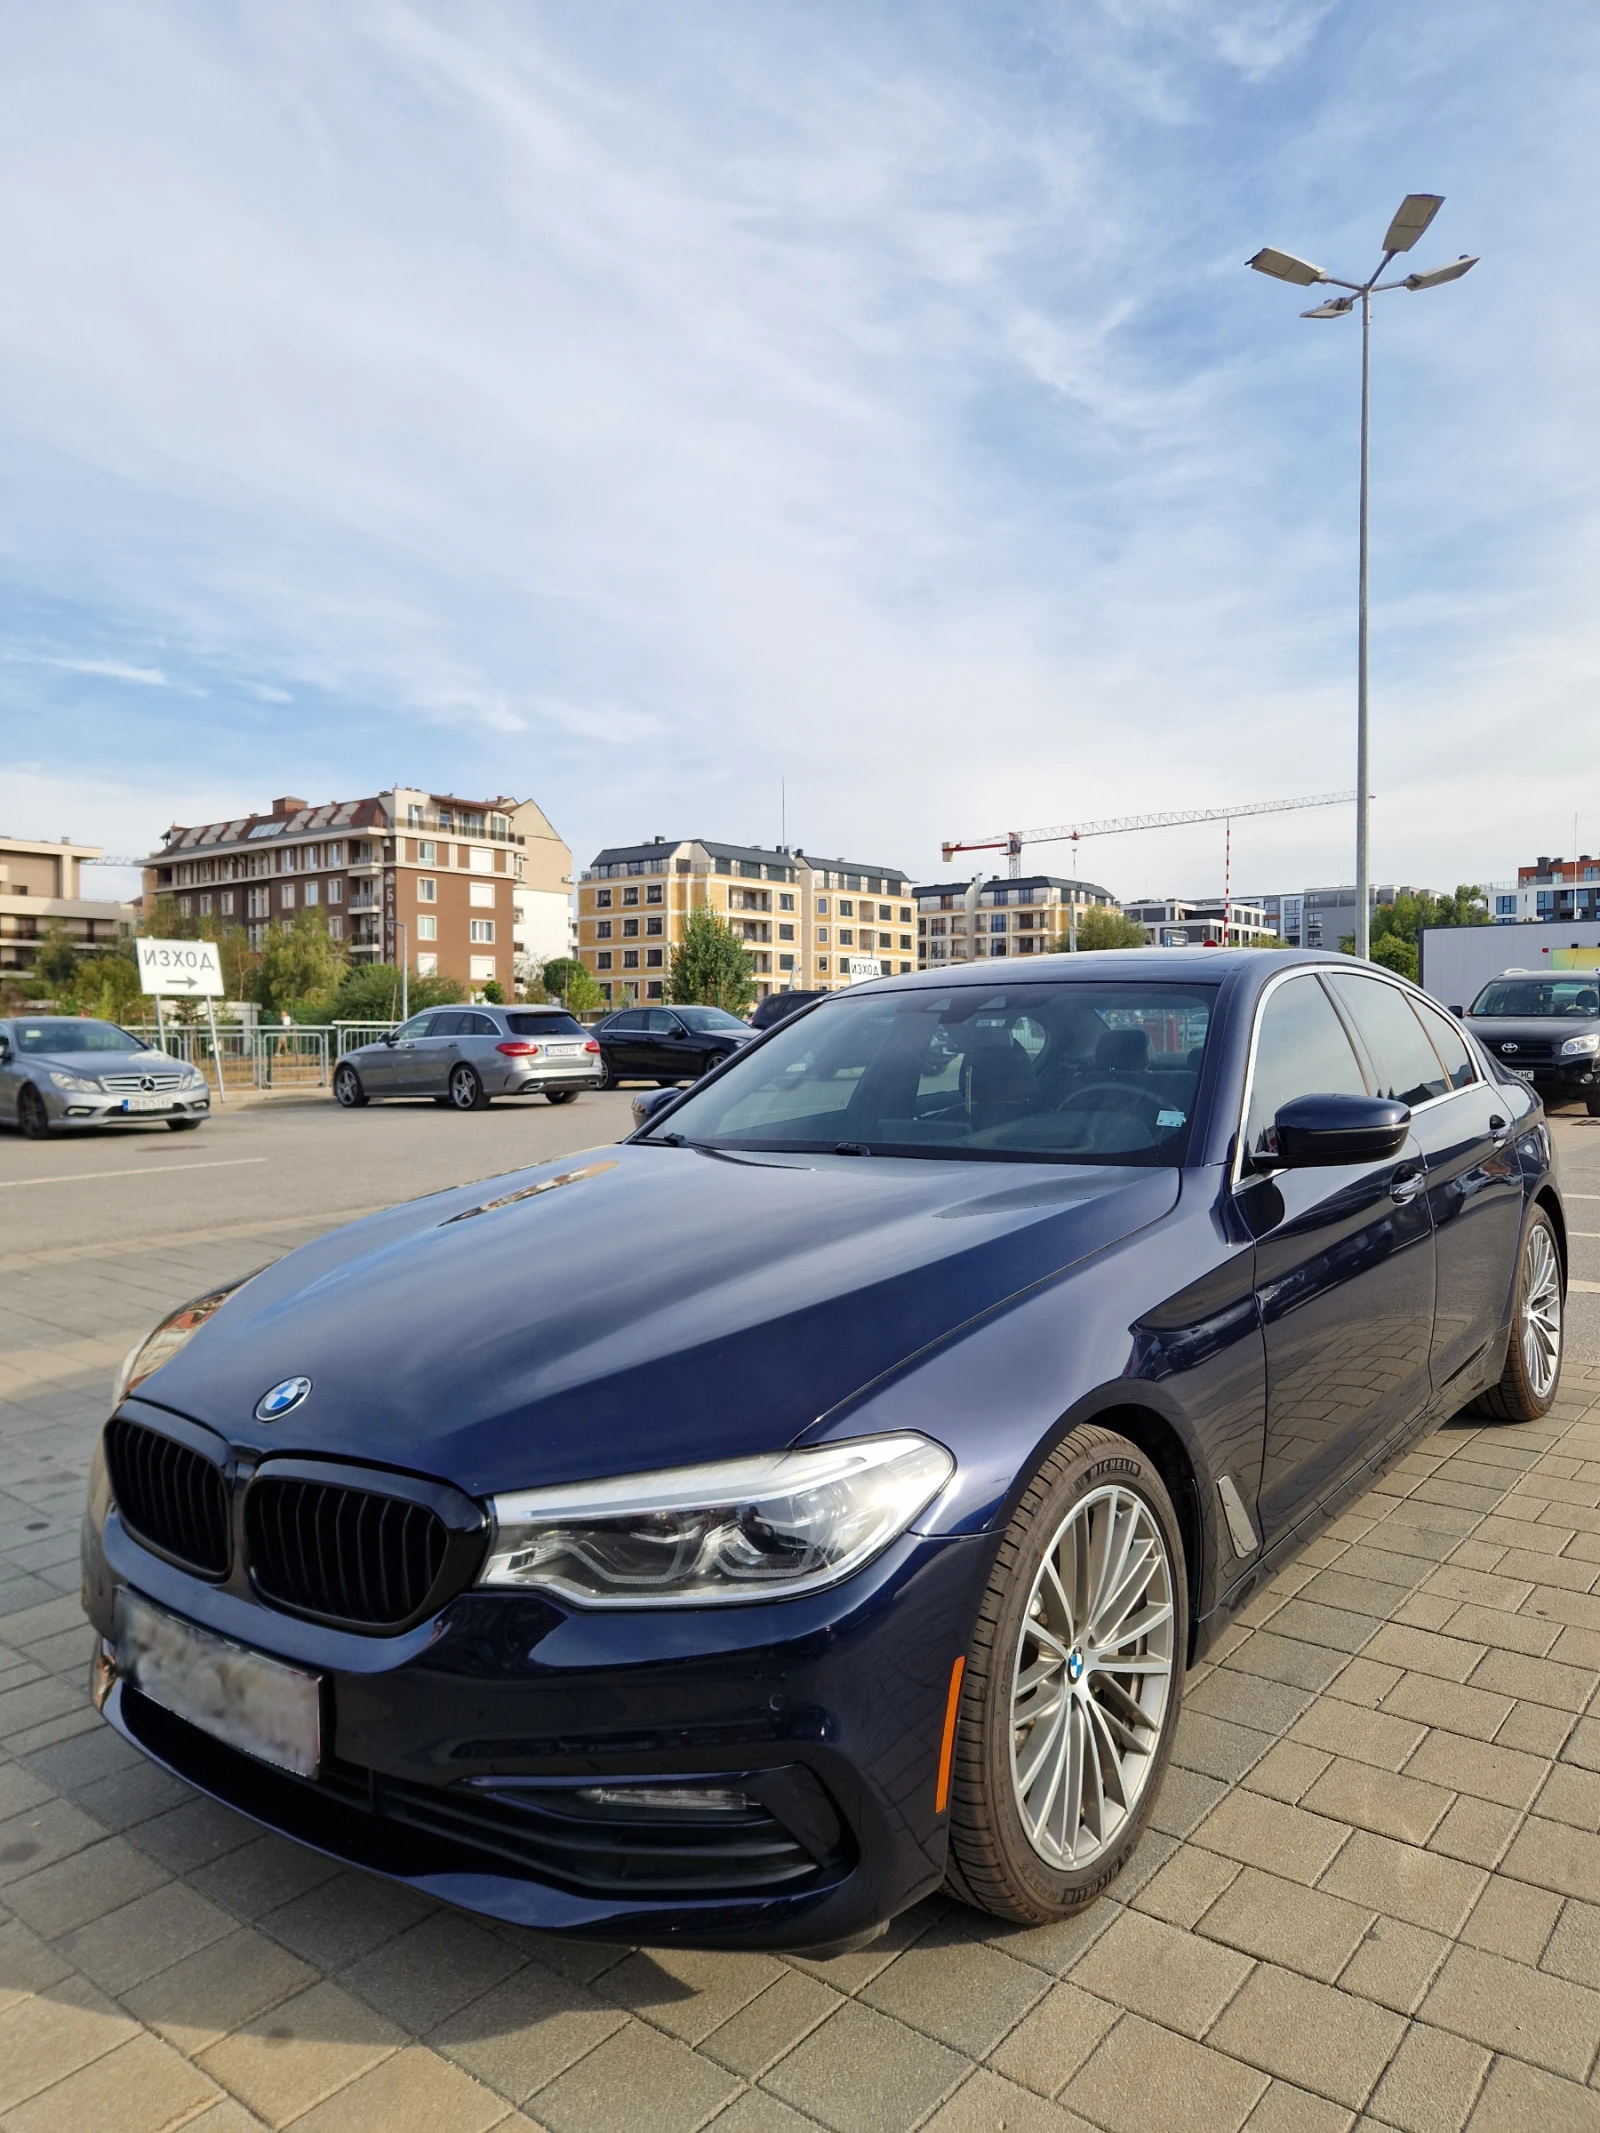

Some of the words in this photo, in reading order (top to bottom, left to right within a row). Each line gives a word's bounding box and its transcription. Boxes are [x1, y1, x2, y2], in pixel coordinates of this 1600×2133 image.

[143, 948, 216, 972] ИЗХОД
[851, 963, 879, 977] ИЗХОД
[1089, 1459, 1139, 1480] MICHELIN
